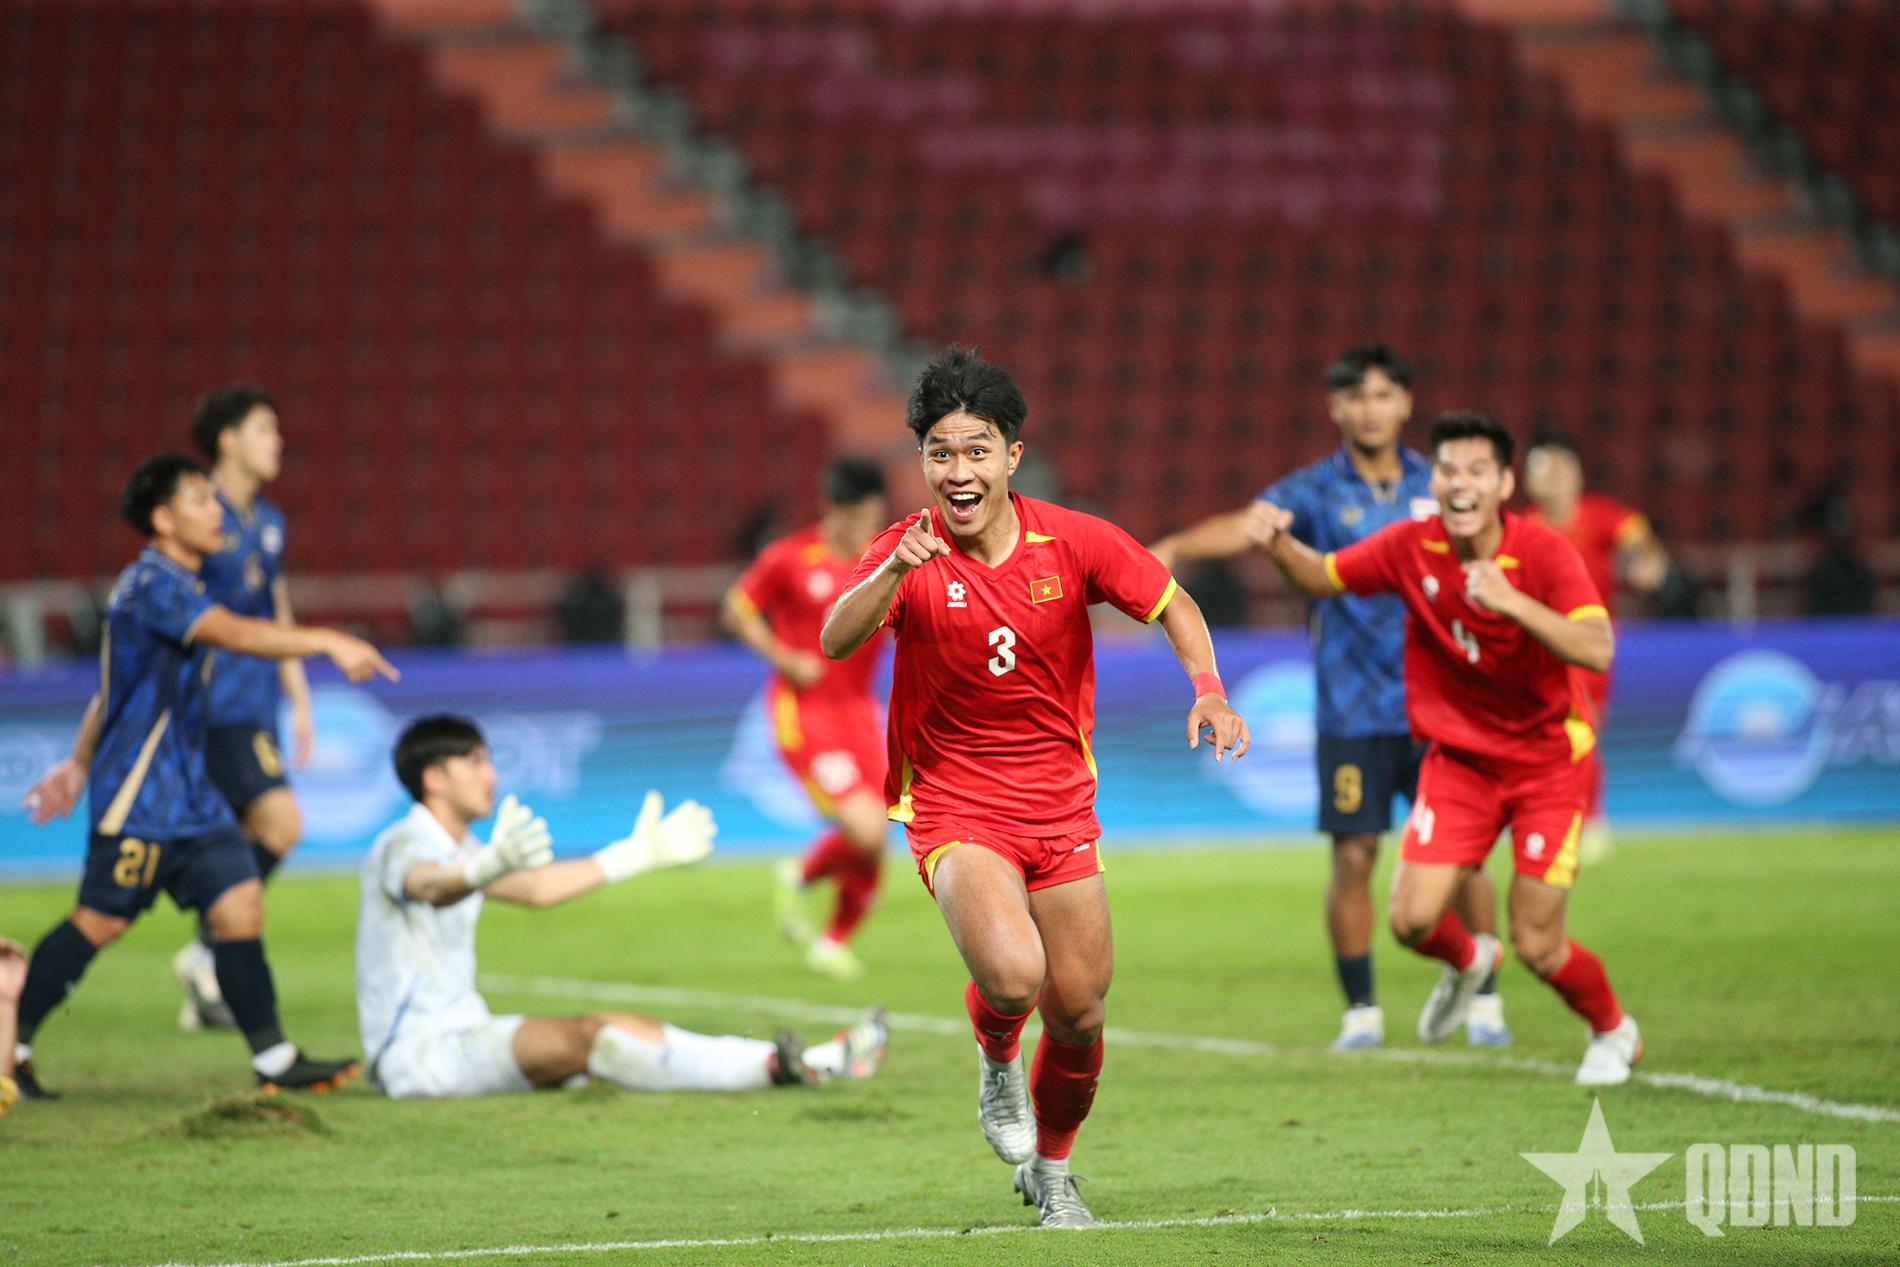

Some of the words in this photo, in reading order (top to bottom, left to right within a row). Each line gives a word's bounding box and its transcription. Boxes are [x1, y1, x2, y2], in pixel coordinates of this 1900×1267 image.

[988, 625, 1016, 677] 3
[1451, 619, 1480, 664] 4
[1333, 763, 1363, 815] 9
[112, 836, 161, 889] 21
